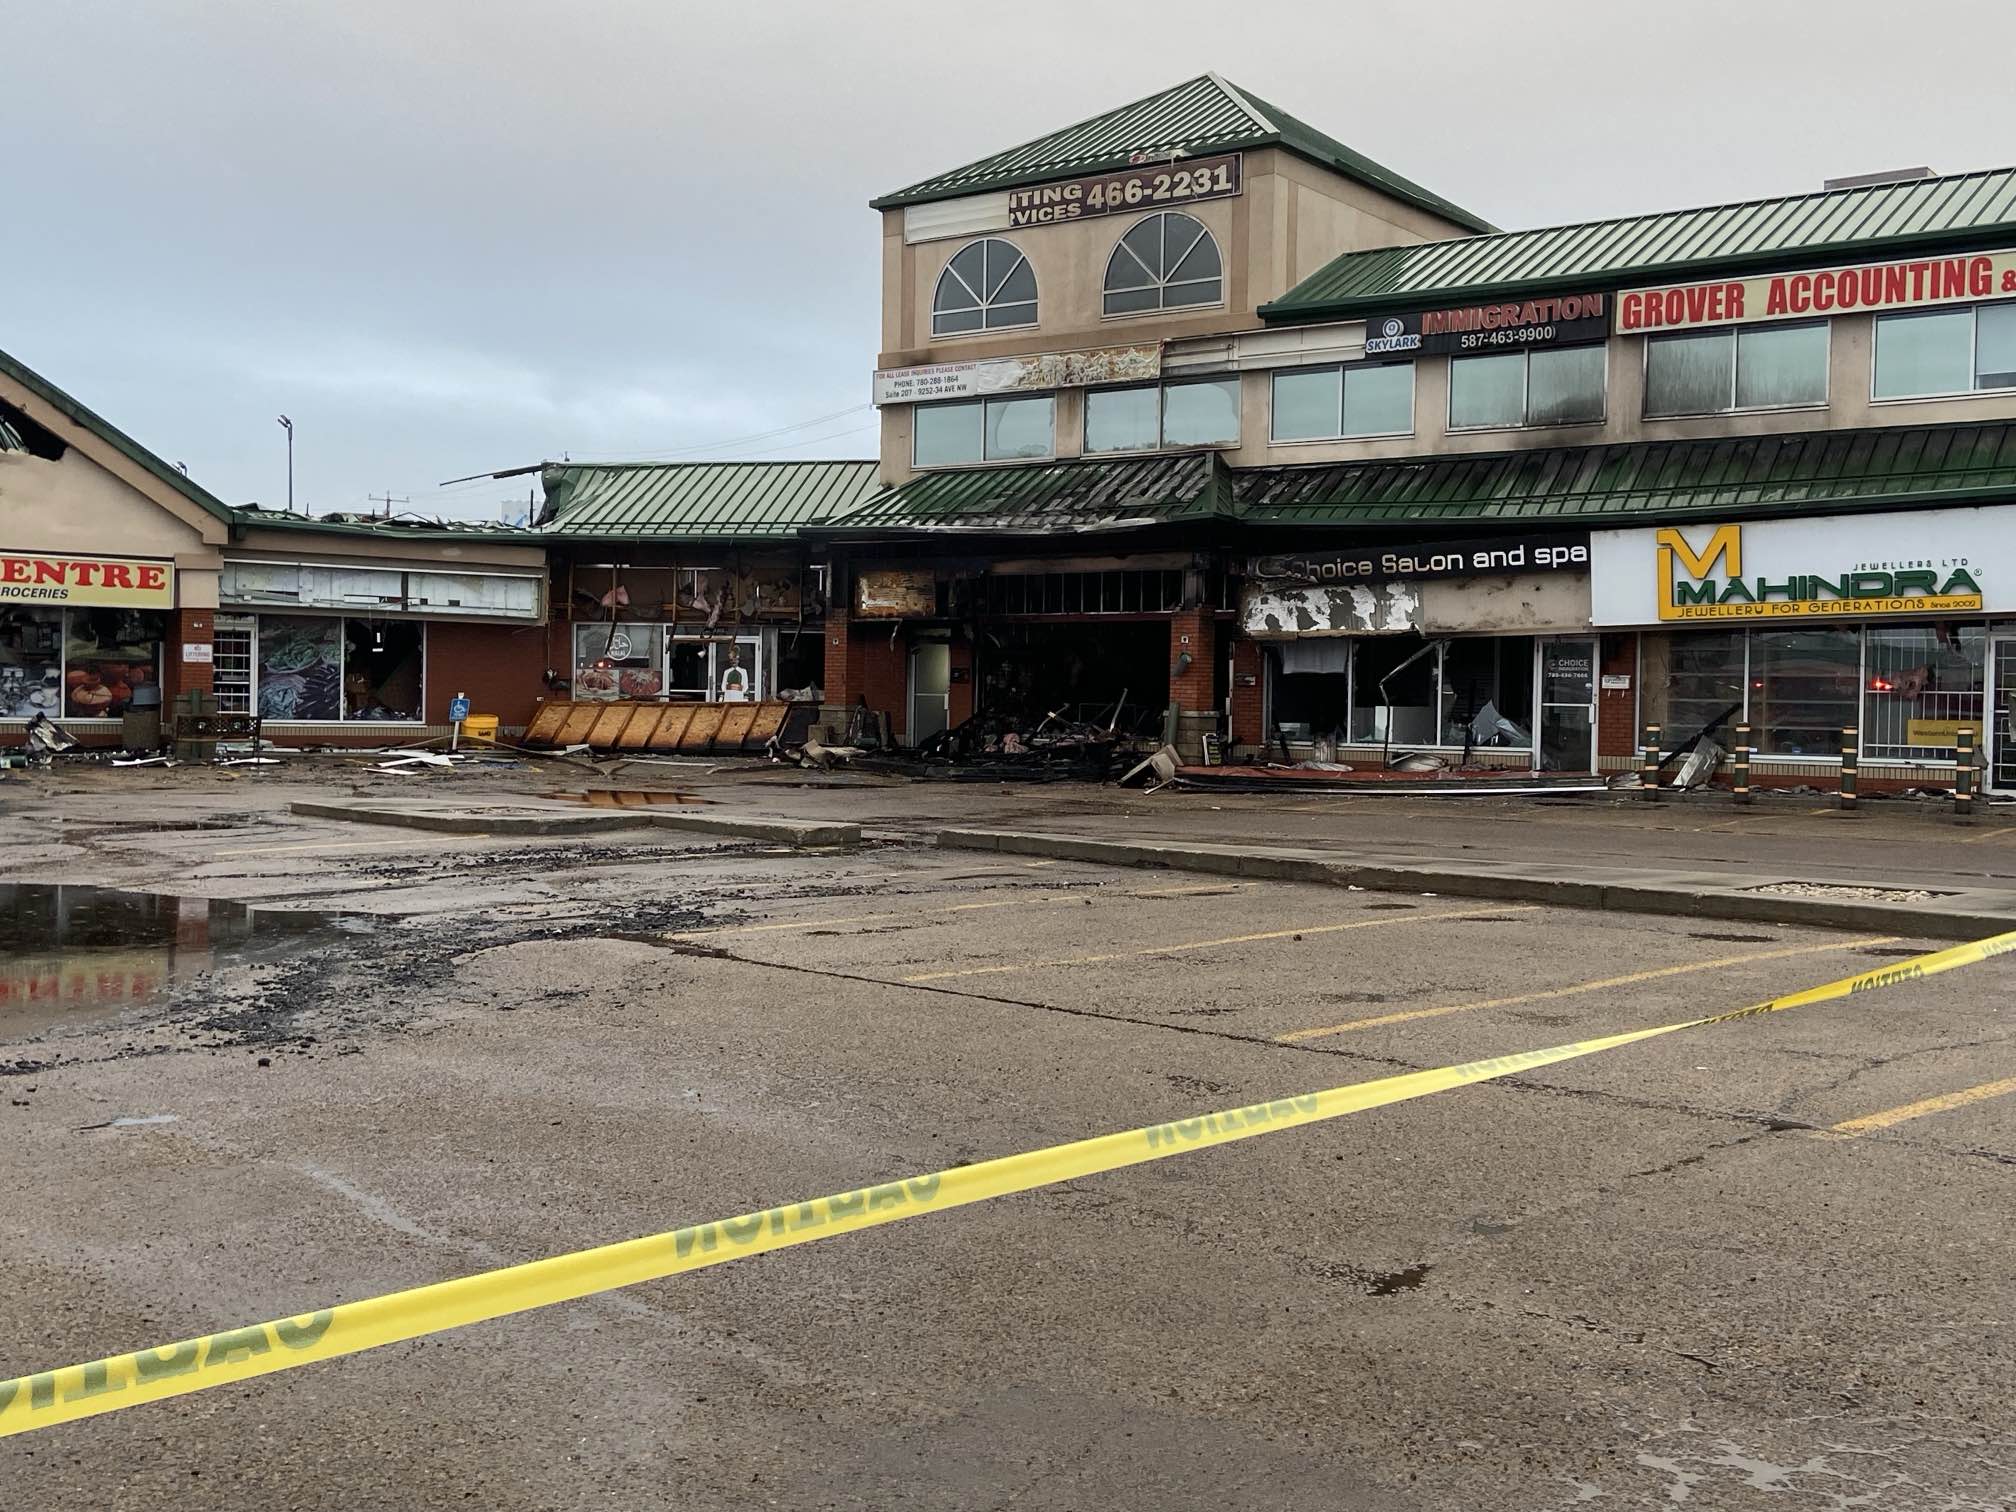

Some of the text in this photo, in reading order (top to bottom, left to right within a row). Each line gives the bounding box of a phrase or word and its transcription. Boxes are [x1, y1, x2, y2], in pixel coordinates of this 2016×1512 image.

[1086, 164, 1233, 209] 466-2231
[1009, 202, 1082, 225] VICES
[1622, 257, 2016, 330] GROVER ACCOUNTING &
[1422, 294, 1603, 335] IMMIGRATION
[1367, 335, 1420, 352] SKYLARK
[1461, 327, 1554, 349] 587-463-9900
[895, 370, 910, 378] LEASE
[936, 366, 953, 374] PLEASE
[954, 364, 977, 372] CONTACT
[944, 385, 955, 393] AVE
[957, 384, 967, 392] NW
[1473, 545, 1525, 568] and
[1534, 544, 1588, 568] spa
[1853, 557, 1969, 571] JEWELLERS LTD
[0, 586, 69, 599] ROCERIES
[1677, 568, 1982, 605] MAHINDRA
[1772, 603, 1801, 614] FOR
[1809, 598, 1925, 612] GENERATIONS
[1558, 659, 1589, 667] CHOICE
